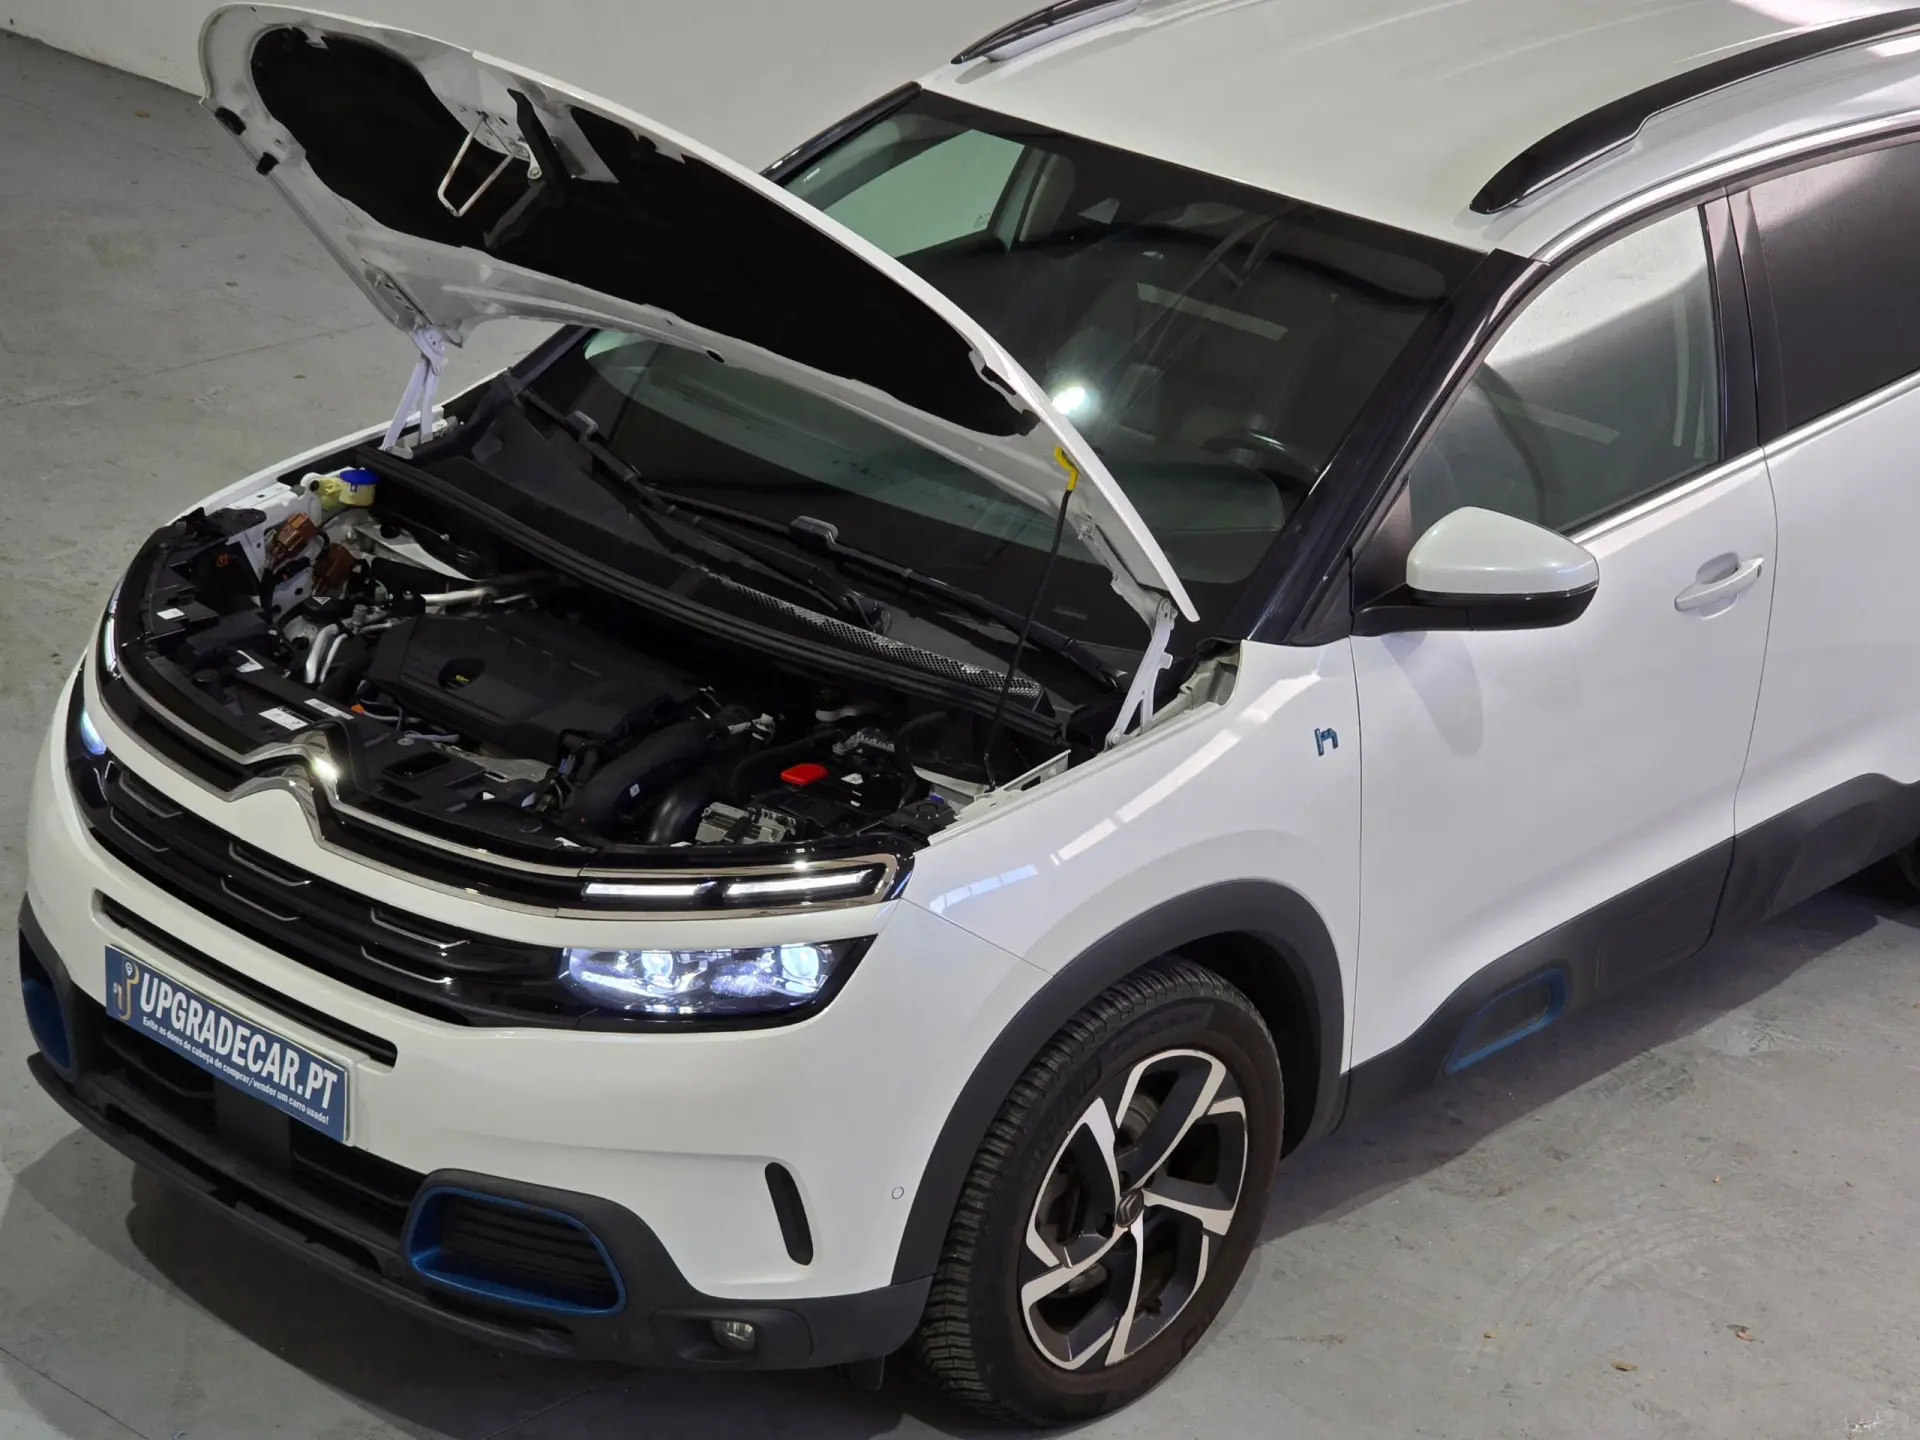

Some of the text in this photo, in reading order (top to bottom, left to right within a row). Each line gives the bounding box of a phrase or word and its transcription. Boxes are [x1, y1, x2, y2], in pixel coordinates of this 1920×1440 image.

[140, 972, 338, 1109] UPGRADECAR.PT
[142, 1016, 159, 1031] Evite
[159, 1026, 167, 1036] as
[167, 1030, 183, 1046] dores
[183, 1040, 192, 1051] de
[191, 1046, 214, 1065] cabeça
[277, 1090, 289, 1104] um
[289, 1097, 306, 1113] carro
[306, 1107, 329, 1125] usado!
